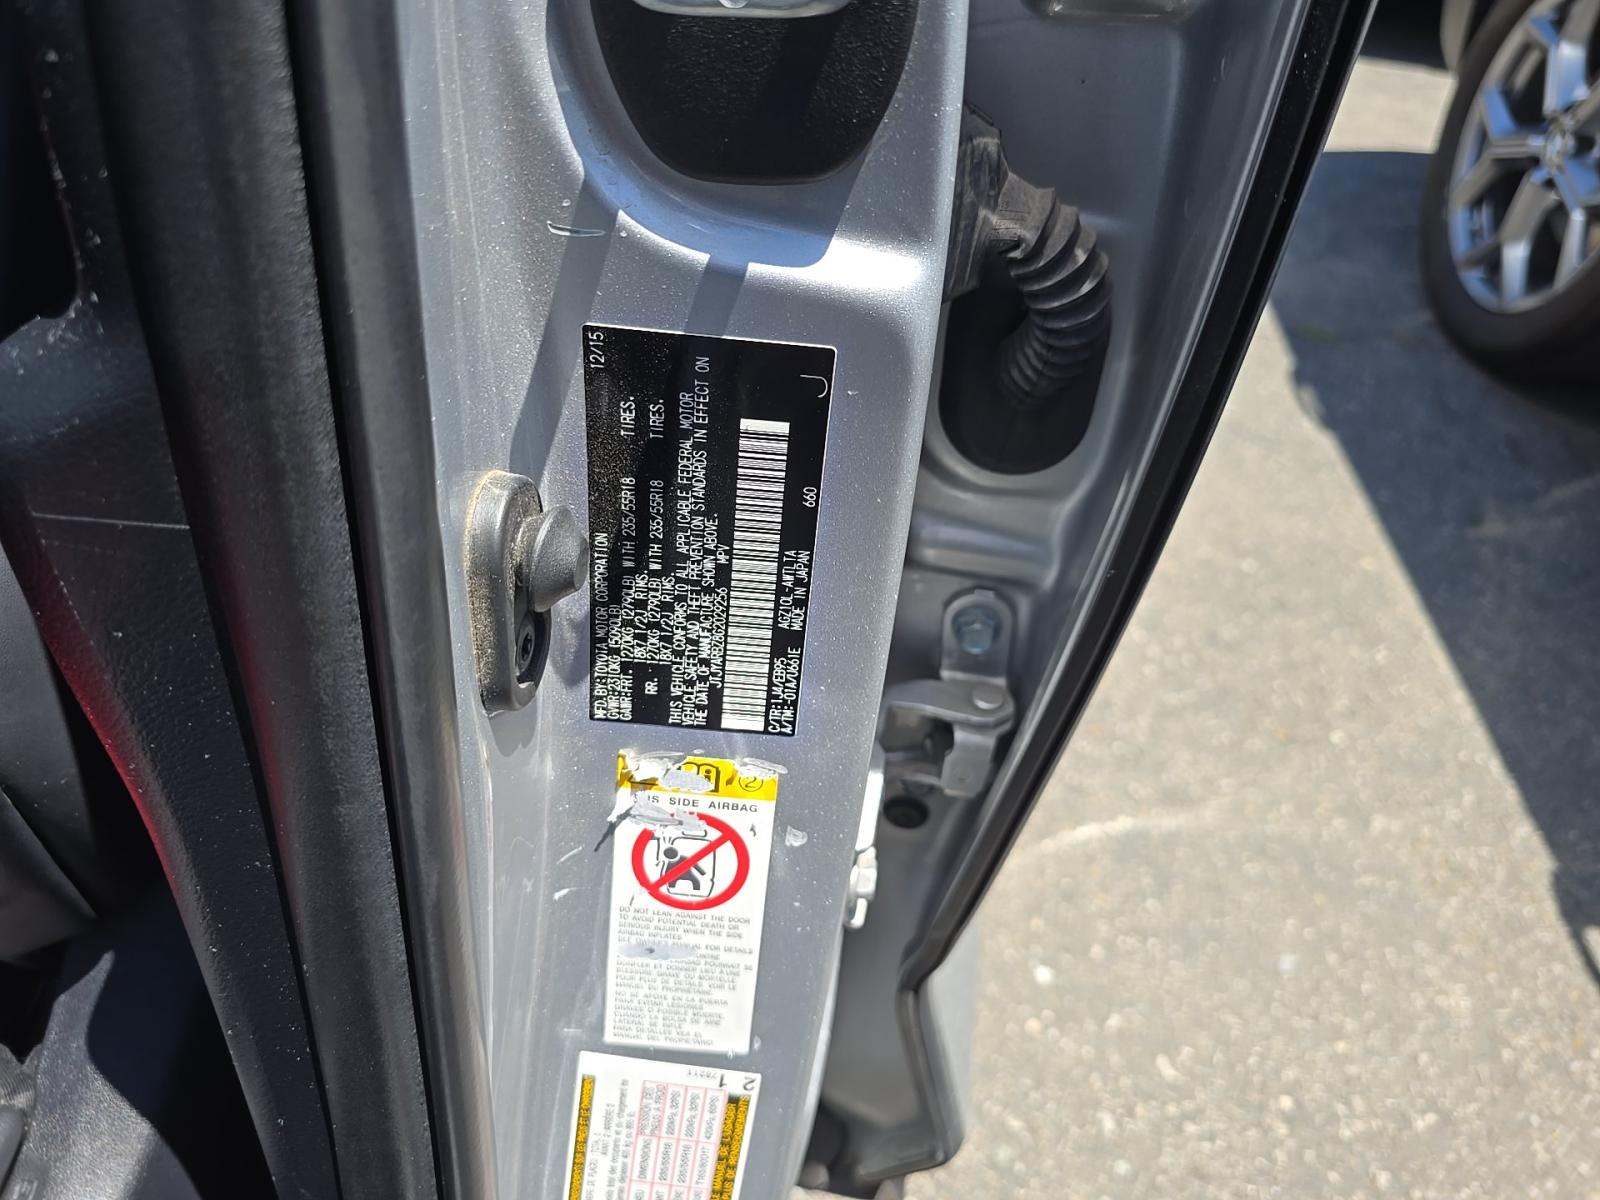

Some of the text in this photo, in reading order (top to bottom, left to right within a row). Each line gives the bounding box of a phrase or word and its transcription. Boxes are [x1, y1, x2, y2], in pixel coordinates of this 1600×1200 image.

[589, 331, 604, 368] 12/15
[620, 395, 634, 437] TIRES.
[621, 476, 635, 536] 235/55R18
[801, 486, 817, 507] 660
[622, 541, 635, 567] WITH
[645, 398, 664, 694] RR. 1270KG (2790LB) WITH 235/55R18 TIRES.
[669, 391, 694, 724] THIS VEHICLE CONFORMS TO ALL APPLICABLE FEDERAL MOTOR
[682, 355, 709, 725] VEHICLE SAFETY AND THEFT PREVENTION STANDARDS IN EFFECT ON
[716, 543, 729, 563] MPV
[594, 532, 608, 601] CORPORATION
[795, 549, 811, 582] JAPAN
[621, 574, 634, 619] (2790LB)
[793, 586, 807, 599] IN
[595, 606, 608, 637] MOTOR
[608, 603, 621, 647] (5090LB)
[634, 569, 647, 662] 18X7 1/2J RIMS.
[659, 571, 674, 664] 18X7 1/2J RIMS.
[694, 512, 718, 726] THE DATE OF MANUFACTURE SHOWN ABOVE.
[790, 606, 805, 630] MADE
[621, 626, 633, 661] 1270KG
[669, 796, 700, 808] SIDE
[708, 801, 758, 812] AIRBAG
